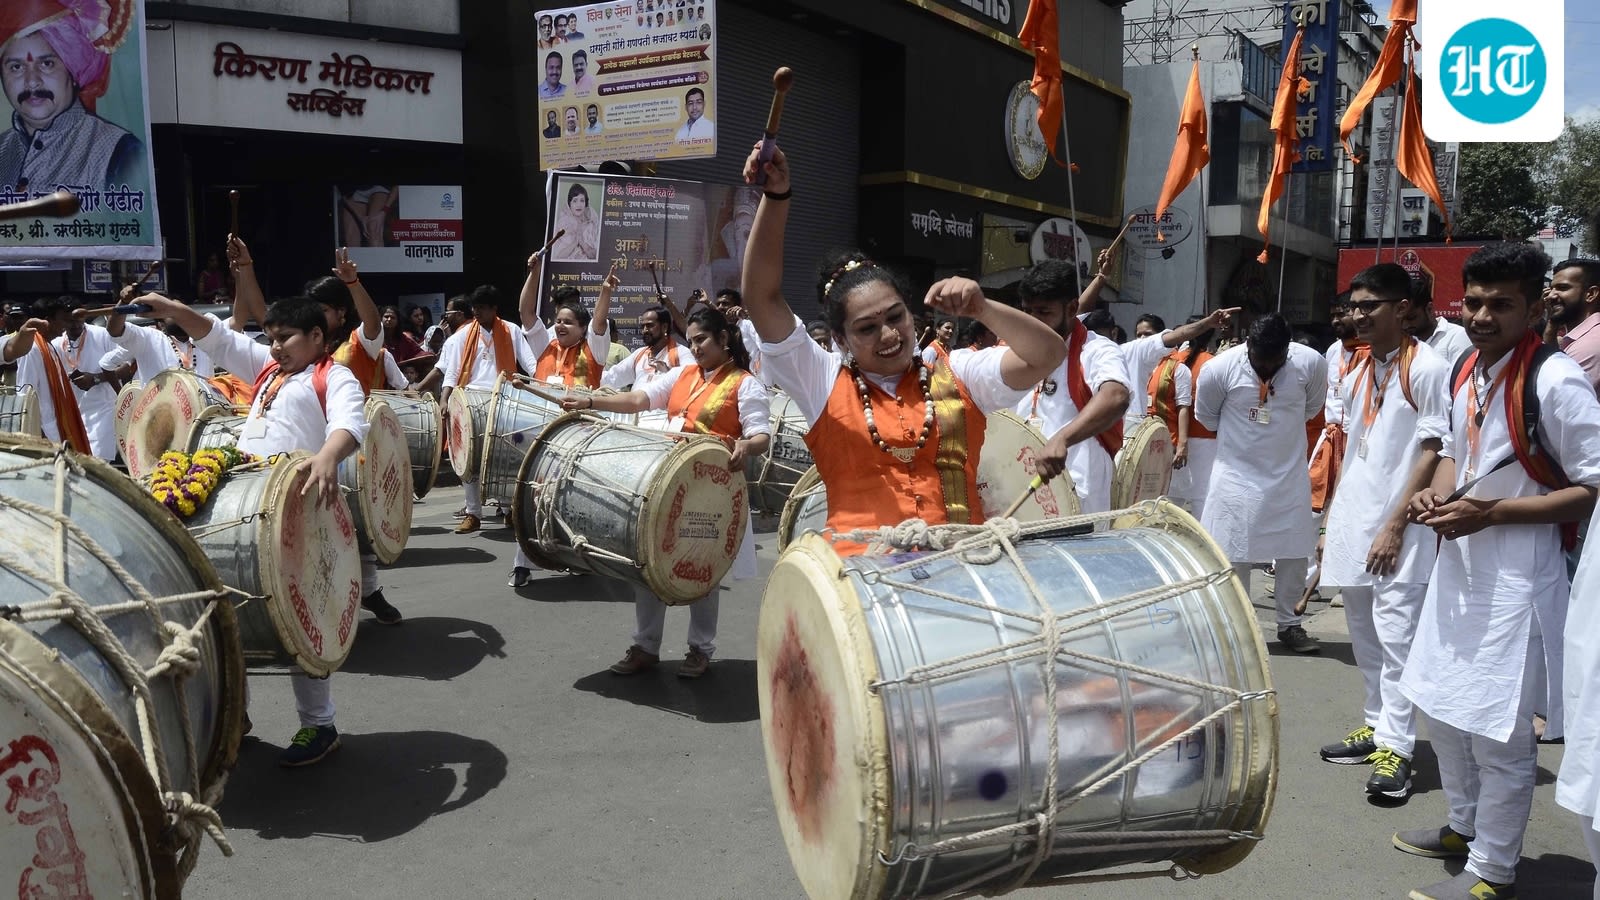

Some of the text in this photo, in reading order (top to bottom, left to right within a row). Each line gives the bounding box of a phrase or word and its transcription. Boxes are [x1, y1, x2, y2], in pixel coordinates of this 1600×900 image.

[213, 41, 434, 95] किरण मेडिकल
[287, 88, 367, 117] सर्व्हिस
[104, 184, 144, 213] पंडीत
[53, 219, 106, 238] ऋषीकेश
[109, 219, 141, 242] गुळवे
[404, 245, 454, 258] वातनाशक
